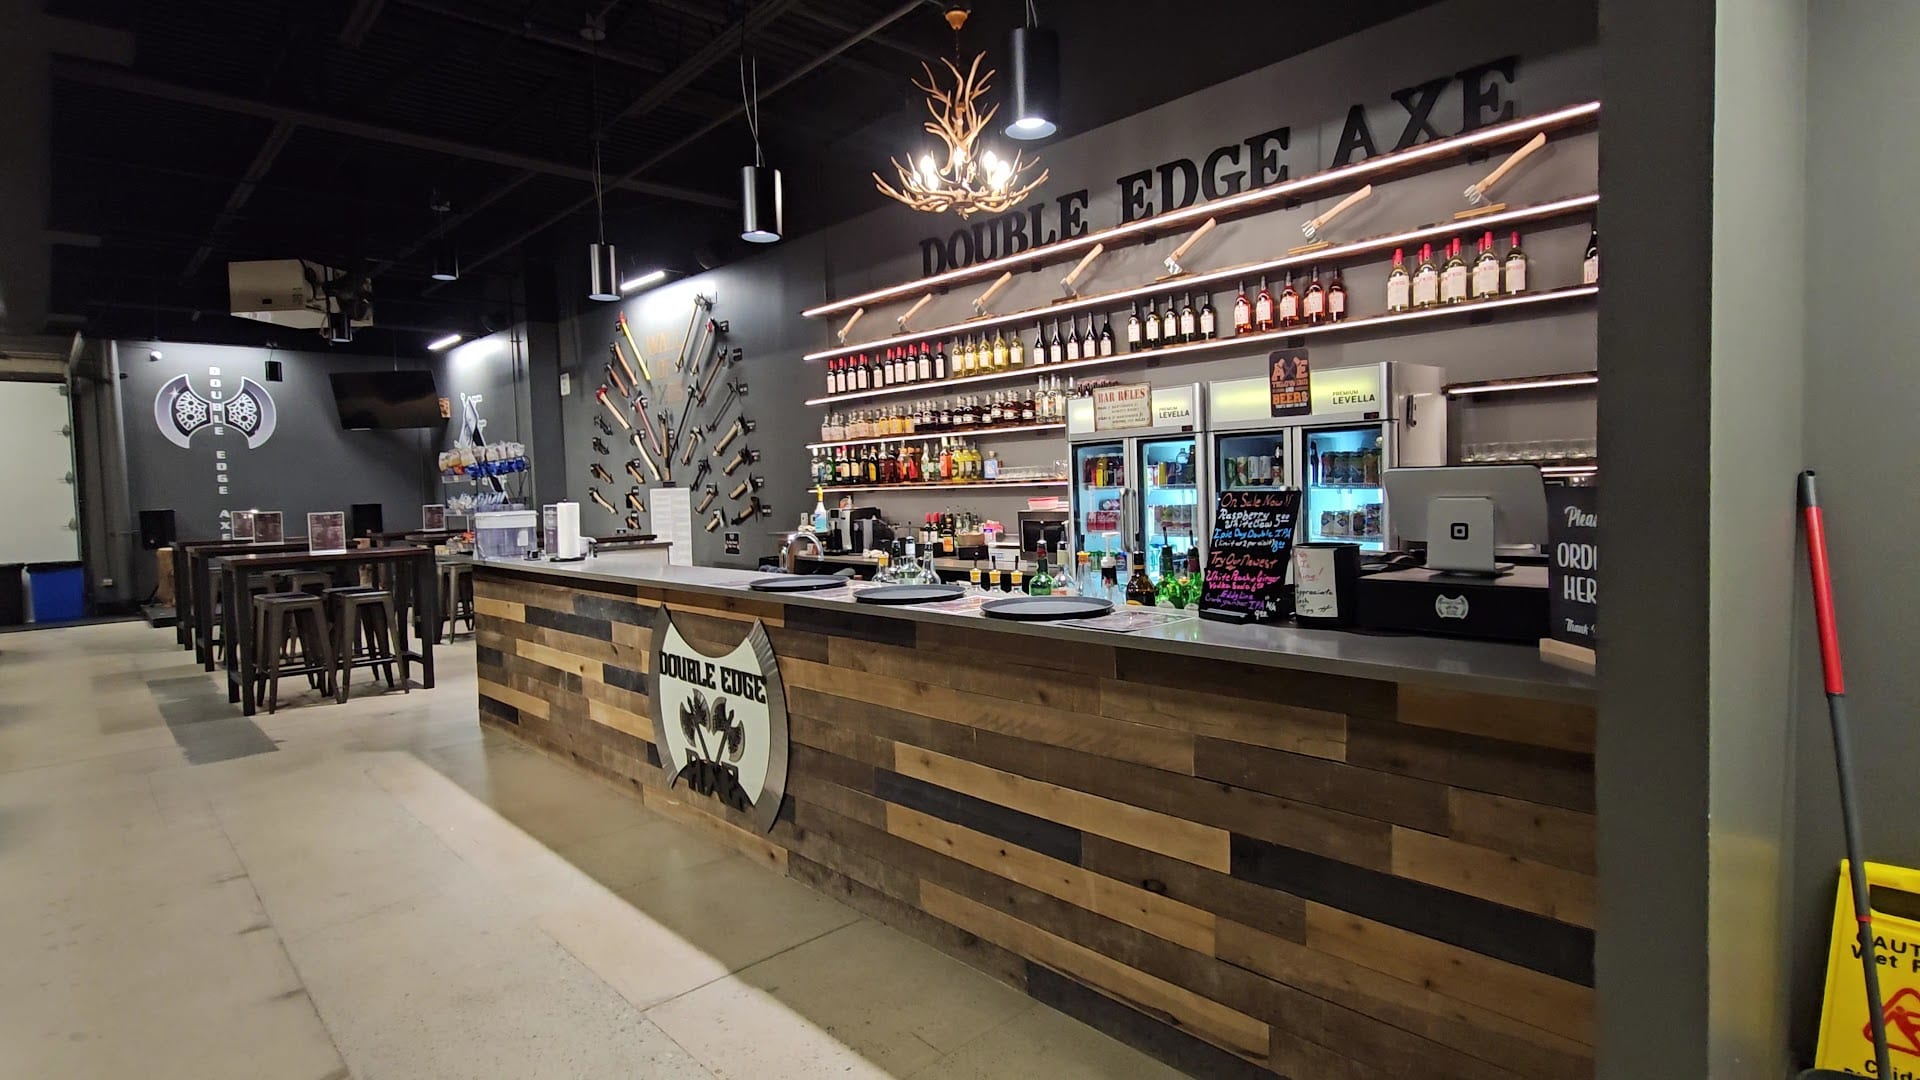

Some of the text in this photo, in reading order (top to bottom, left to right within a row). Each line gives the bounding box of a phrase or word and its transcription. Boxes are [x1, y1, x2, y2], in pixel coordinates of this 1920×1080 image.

[919, 55, 1520, 277] DOUBLE EDGE AXE
[209, 366, 225, 436] DOUBLE
[1332, 394, 1375, 405] LEVELLA
[1159, 410, 1190, 419] LEVELLA
[216, 450, 229, 494] EDGE
[1220, 492, 1238, 508] On
[1240, 492, 1262, 508] Sale
[219, 509, 231, 541] AXE
[1218, 508, 1271, 521] Raspberry
[1211, 551, 1226, 568] Try
[1564, 574, 1597, 604] HER
[1565, 618, 1588, 636] Thank
[659, 651, 767, 704] DOUBLE EDGE
